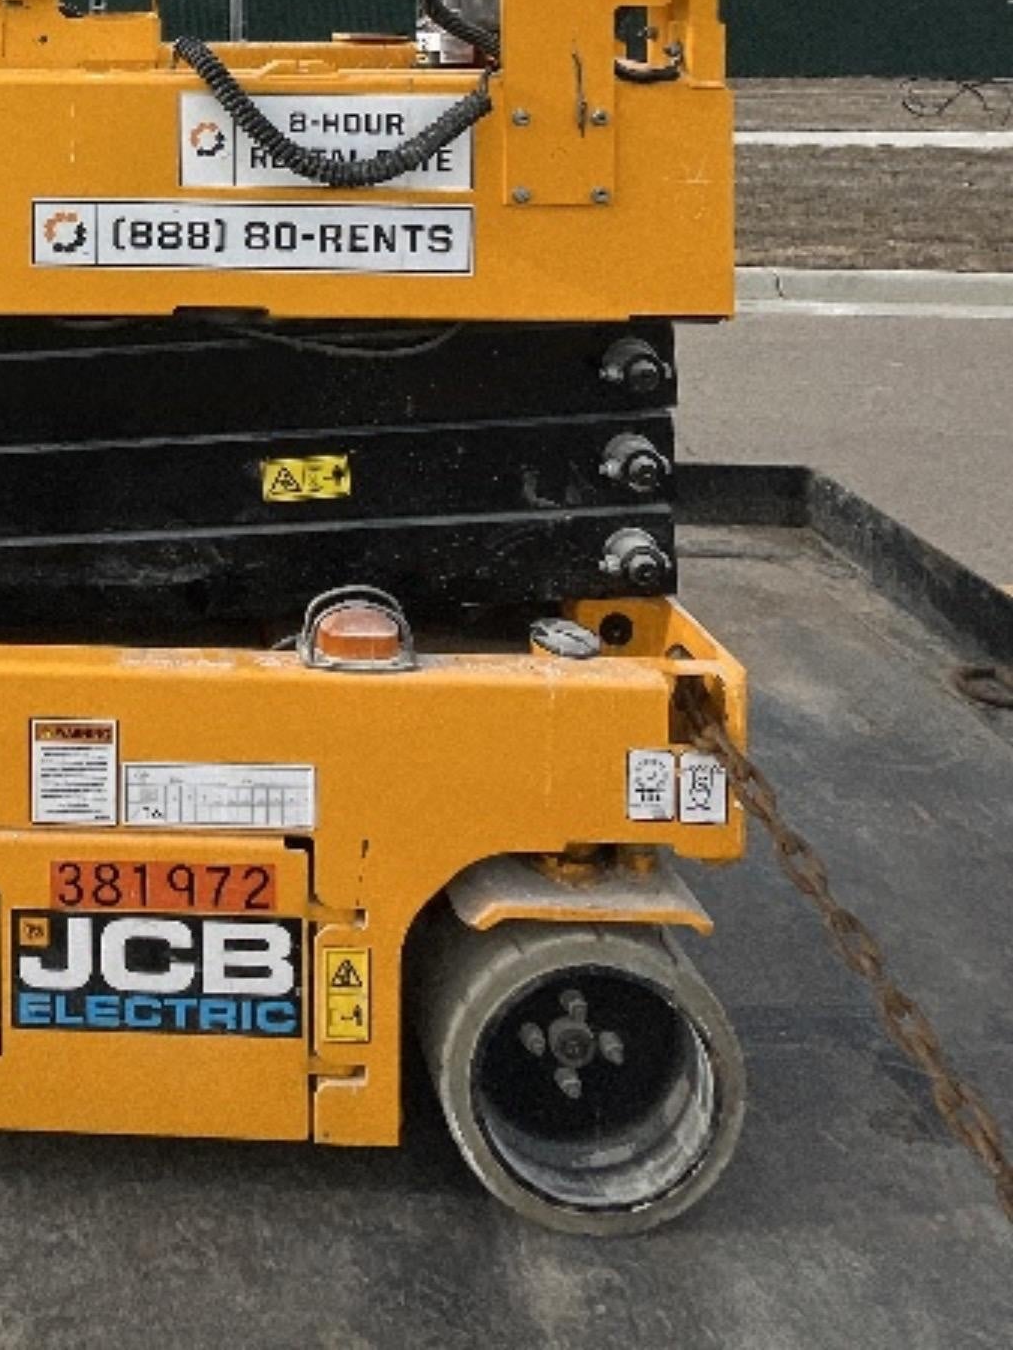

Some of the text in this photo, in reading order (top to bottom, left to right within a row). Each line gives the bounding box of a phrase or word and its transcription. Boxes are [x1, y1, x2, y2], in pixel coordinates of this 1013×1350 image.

[288, 112, 405, 135] 8-HOUR
[112, 218, 454, 255] (888) 80-RENTS
[57, 862, 272, 911] 381972
[19, 917, 295, 996] JCB
[18, 992, 297, 1034] ELECTRIC
